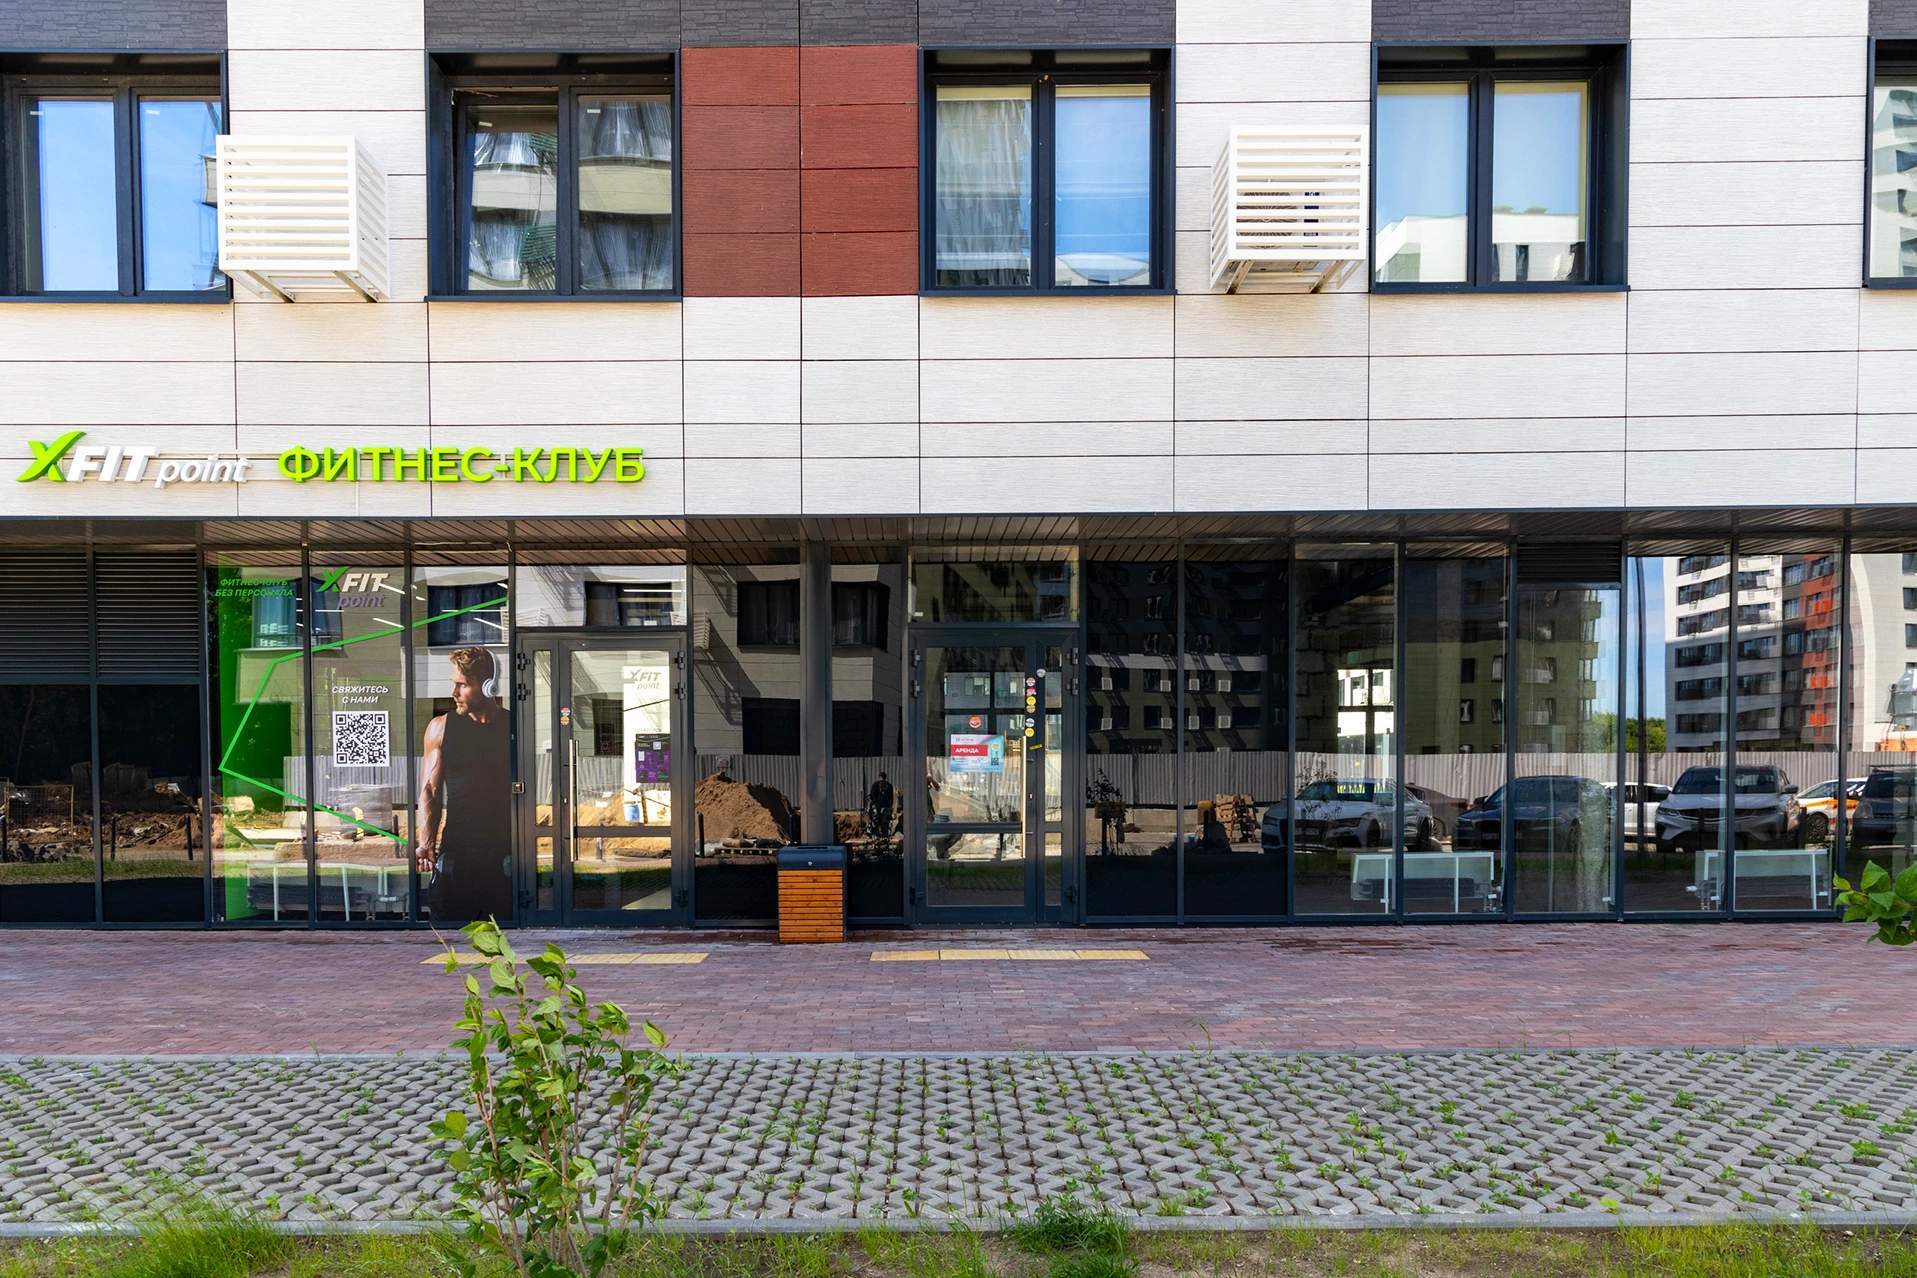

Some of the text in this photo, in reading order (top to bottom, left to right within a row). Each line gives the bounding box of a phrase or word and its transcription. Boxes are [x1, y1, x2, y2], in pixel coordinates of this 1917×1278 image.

[16, 431, 251, 489] XFIT point
[278, 446, 646, 483] ФИТНЕС-КЛУБ
[315, 566, 388, 593] XFIT
[215, 588, 234, 597] БЕЗ
[336, 594, 385, 609] point
[331, 685, 389, 694] СВЯЖИТЕСЬ
[637, 681, 660, 689] point
[342, 695, 379, 704] С НАМИ
